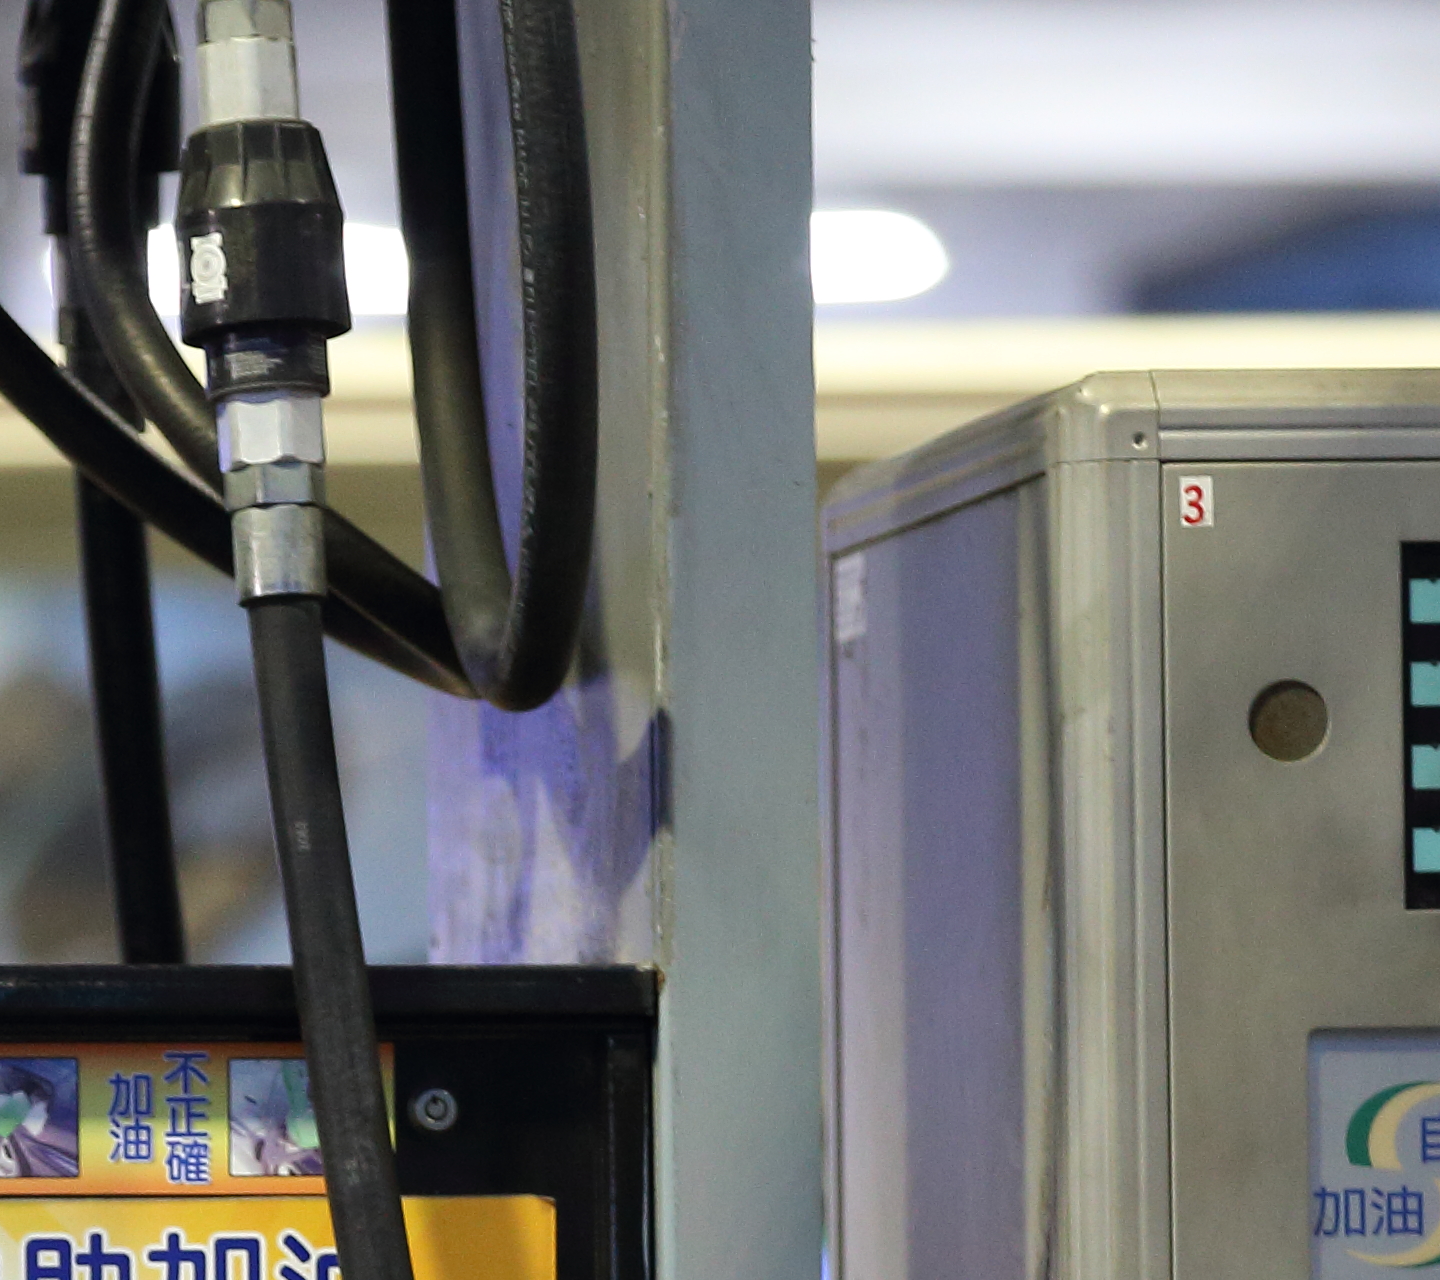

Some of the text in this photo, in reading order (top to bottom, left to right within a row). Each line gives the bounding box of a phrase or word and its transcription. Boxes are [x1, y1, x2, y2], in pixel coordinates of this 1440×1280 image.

[1184, 486, 1205, 525] 3
[109, 1051, 210, 1184] 不正確 加油
[1314, 1186, 1425, 1237] 加油
